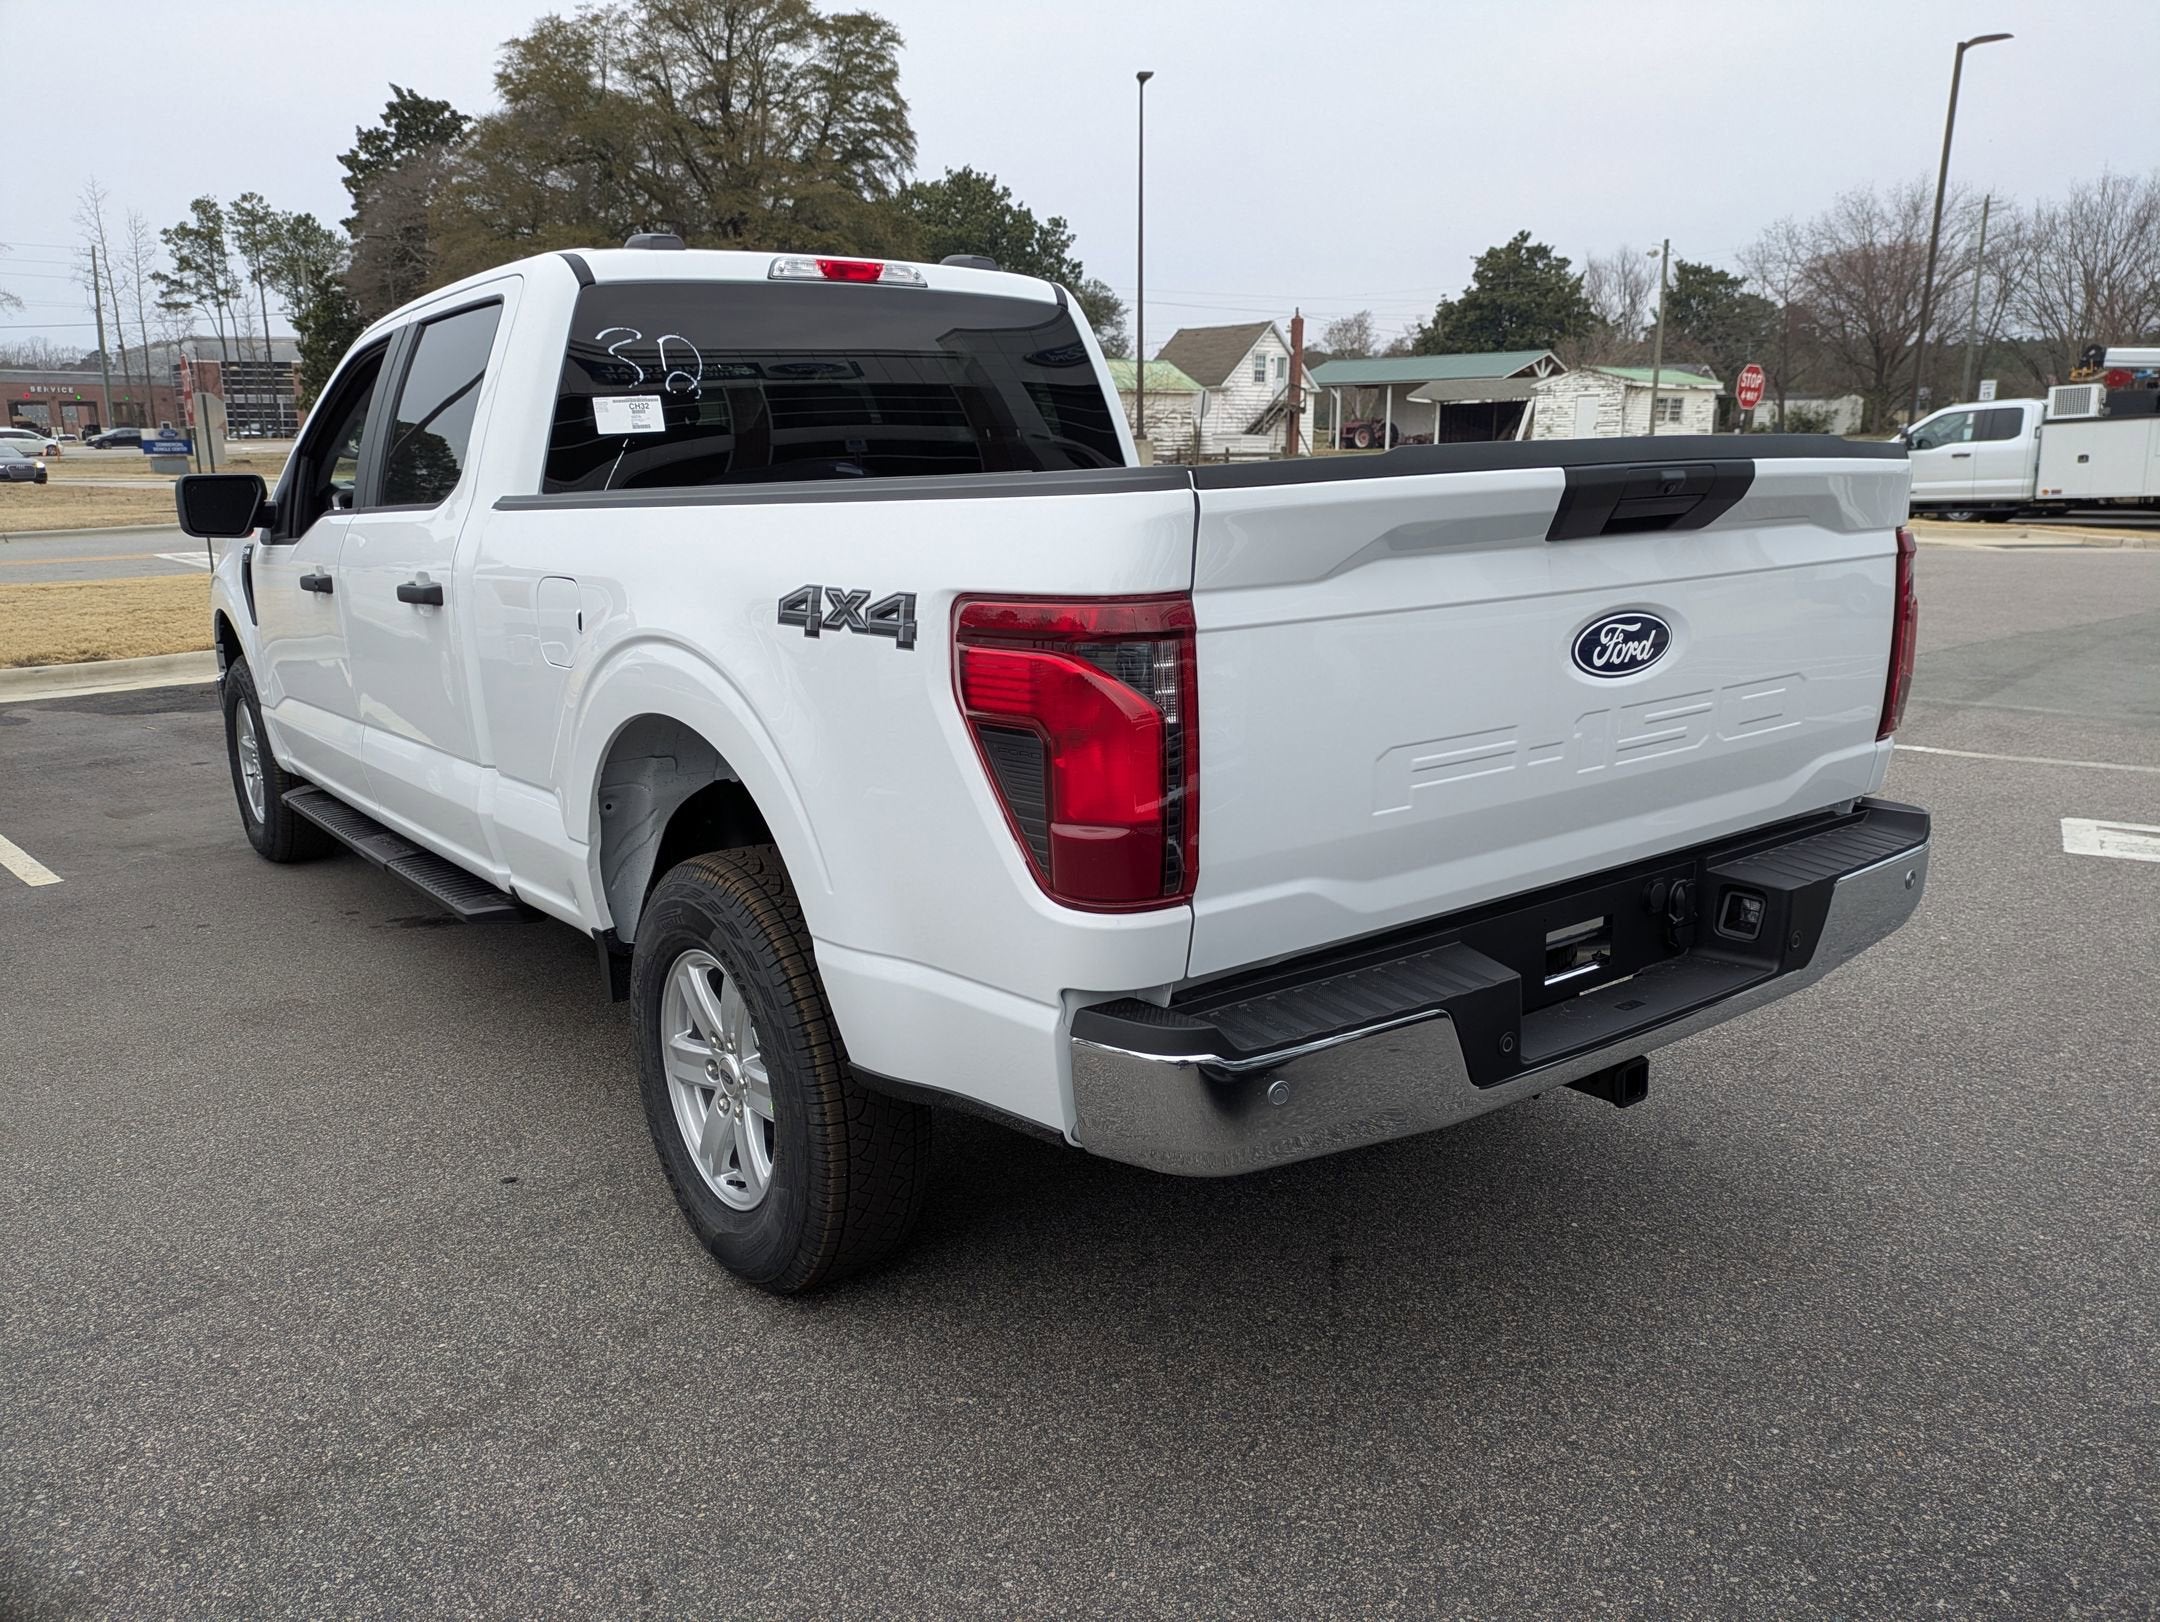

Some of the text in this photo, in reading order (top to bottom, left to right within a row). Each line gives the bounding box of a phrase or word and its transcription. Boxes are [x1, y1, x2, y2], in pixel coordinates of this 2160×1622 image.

[1741, 373, 1762, 388] STOP
[30, 385, 75, 393] SERVICE
[1592, 621, 1656, 668] Ford
[1371, 672, 1807, 817] F-150
[997, 746, 1042, 760] FORD
